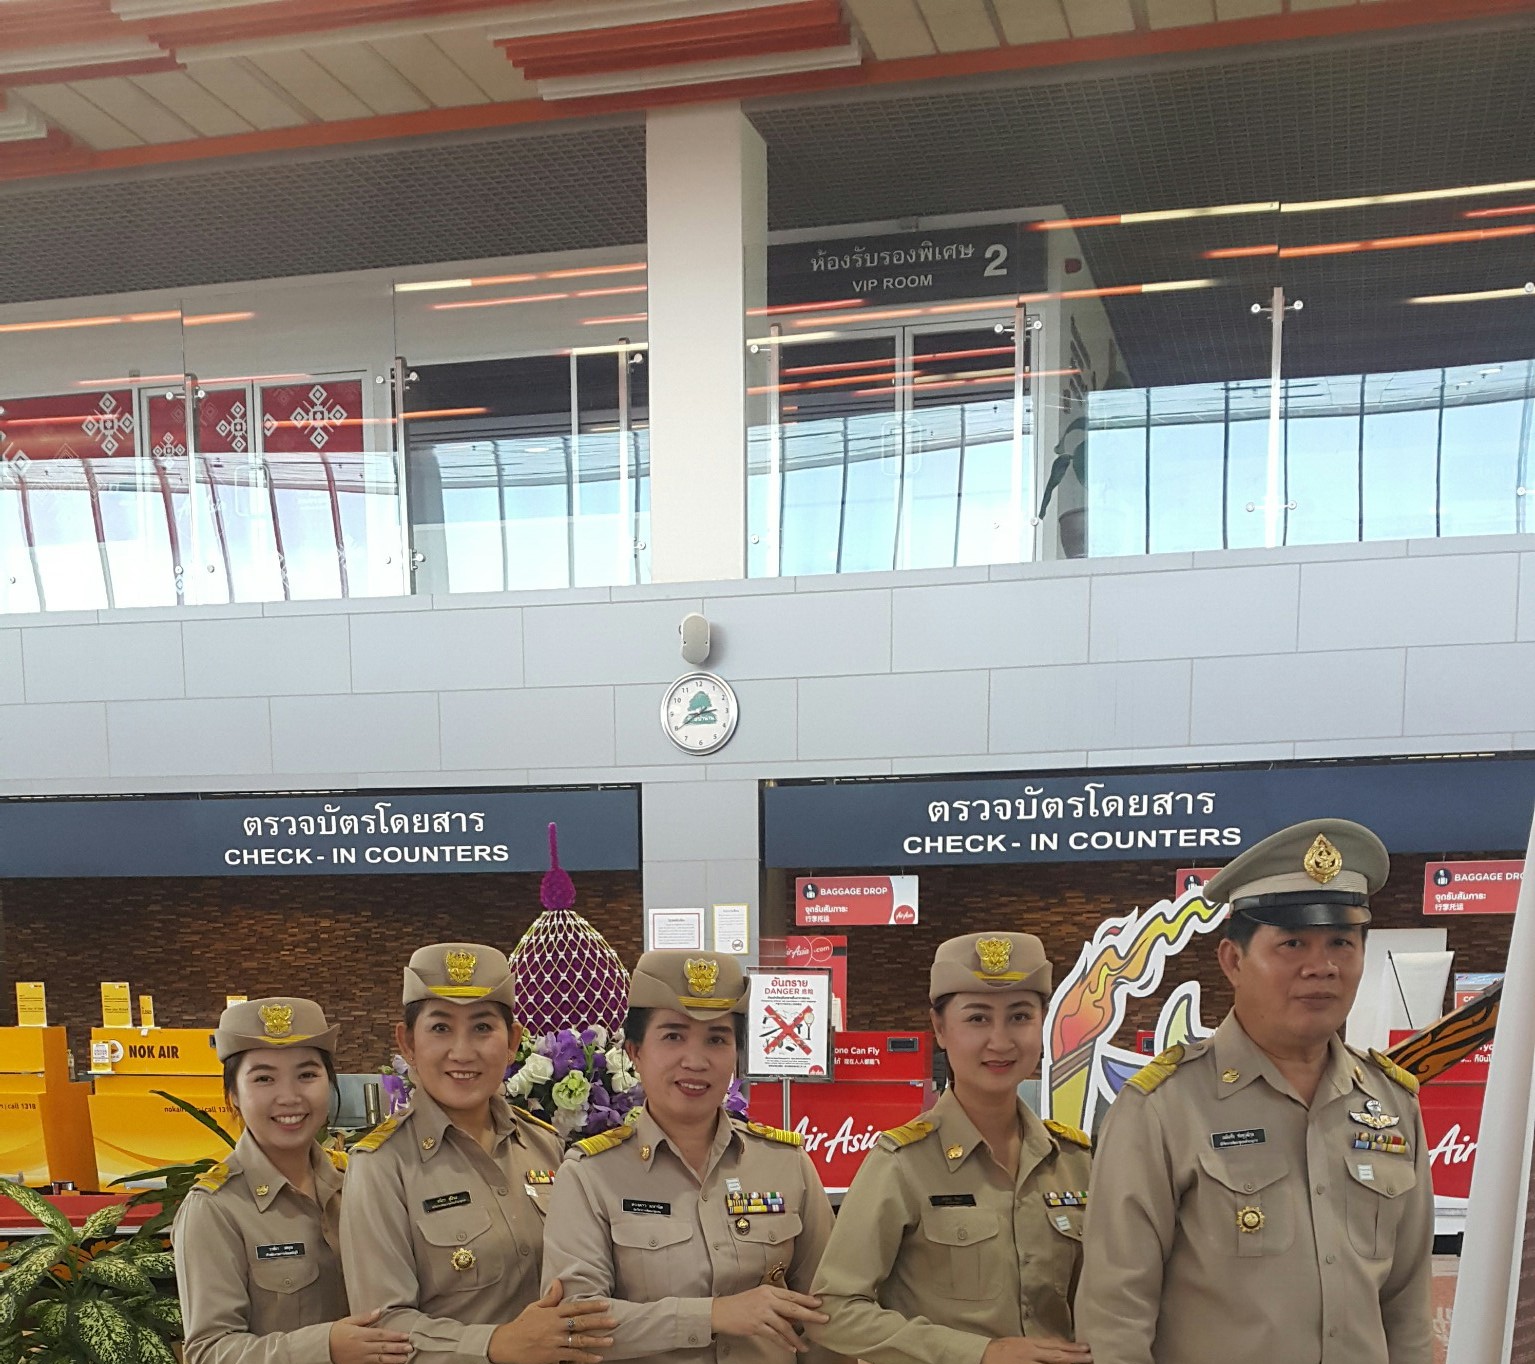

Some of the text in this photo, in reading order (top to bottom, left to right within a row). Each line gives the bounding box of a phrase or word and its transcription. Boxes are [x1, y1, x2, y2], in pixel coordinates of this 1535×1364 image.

[811, 240, 1008, 277] ห้องรับรองพิเศษ 2
[852, 274, 933, 292] VIP ROOM
[928, 783, 1216, 822] ตรวจบัตรโดยสาร
[243, 802, 485, 836] ตรวจบัตรโดยสาร
[1068, 827, 1242, 850] COUNTERS
[364, 845, 509, 863] COUNTERS
[1454, 873, 1503, 882] BAGGAGE
[863, 887, 888, 895] DROP
[764, 987, 800, 995] DANGER
[128, 1045, 179, 1059] NOK AIR
[850, 1047, 866, 1055] Can
[867, 1047, 880, 1056] Fly
